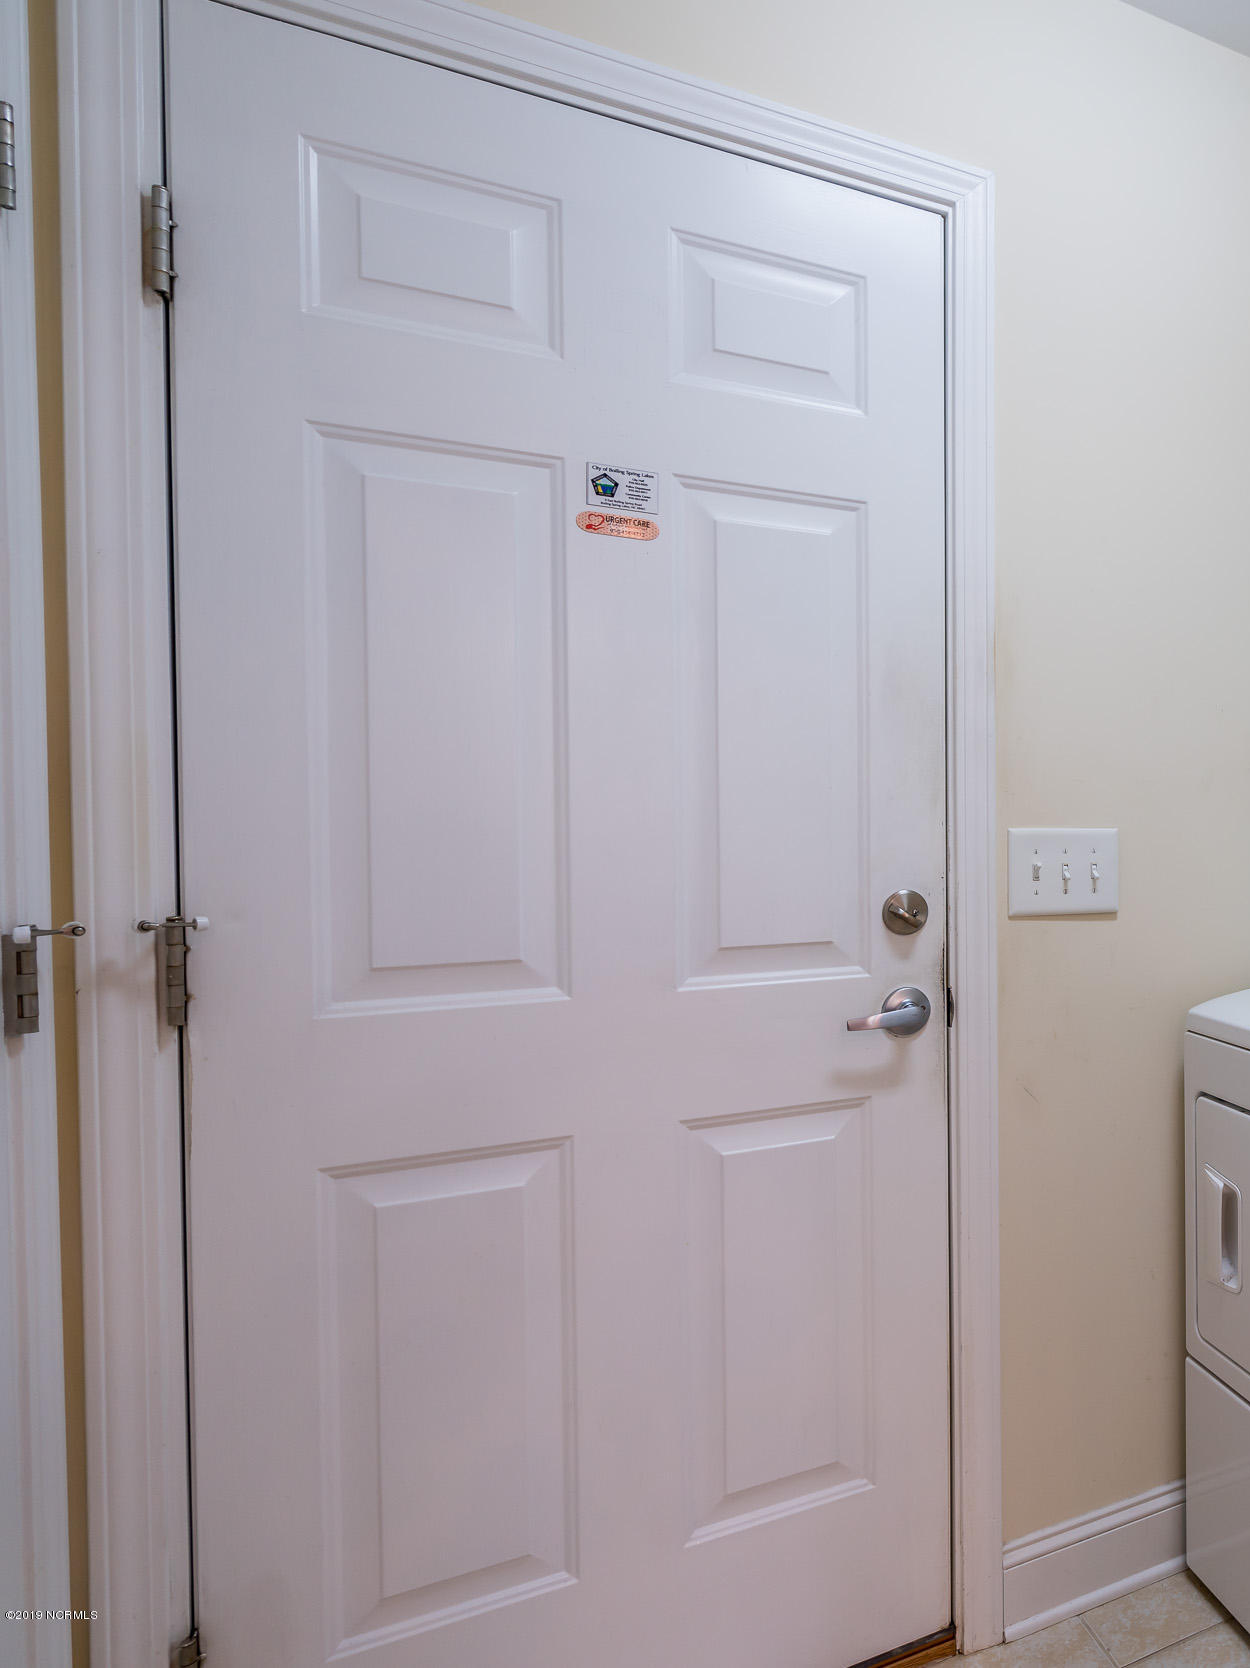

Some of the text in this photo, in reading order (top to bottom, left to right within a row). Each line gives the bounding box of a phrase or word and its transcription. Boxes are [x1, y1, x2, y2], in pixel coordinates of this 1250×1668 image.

[626, 470, 641, 478] Spring
[605, 515, 632, 524] URGENT
[633, 519, 650, 528] CARE
